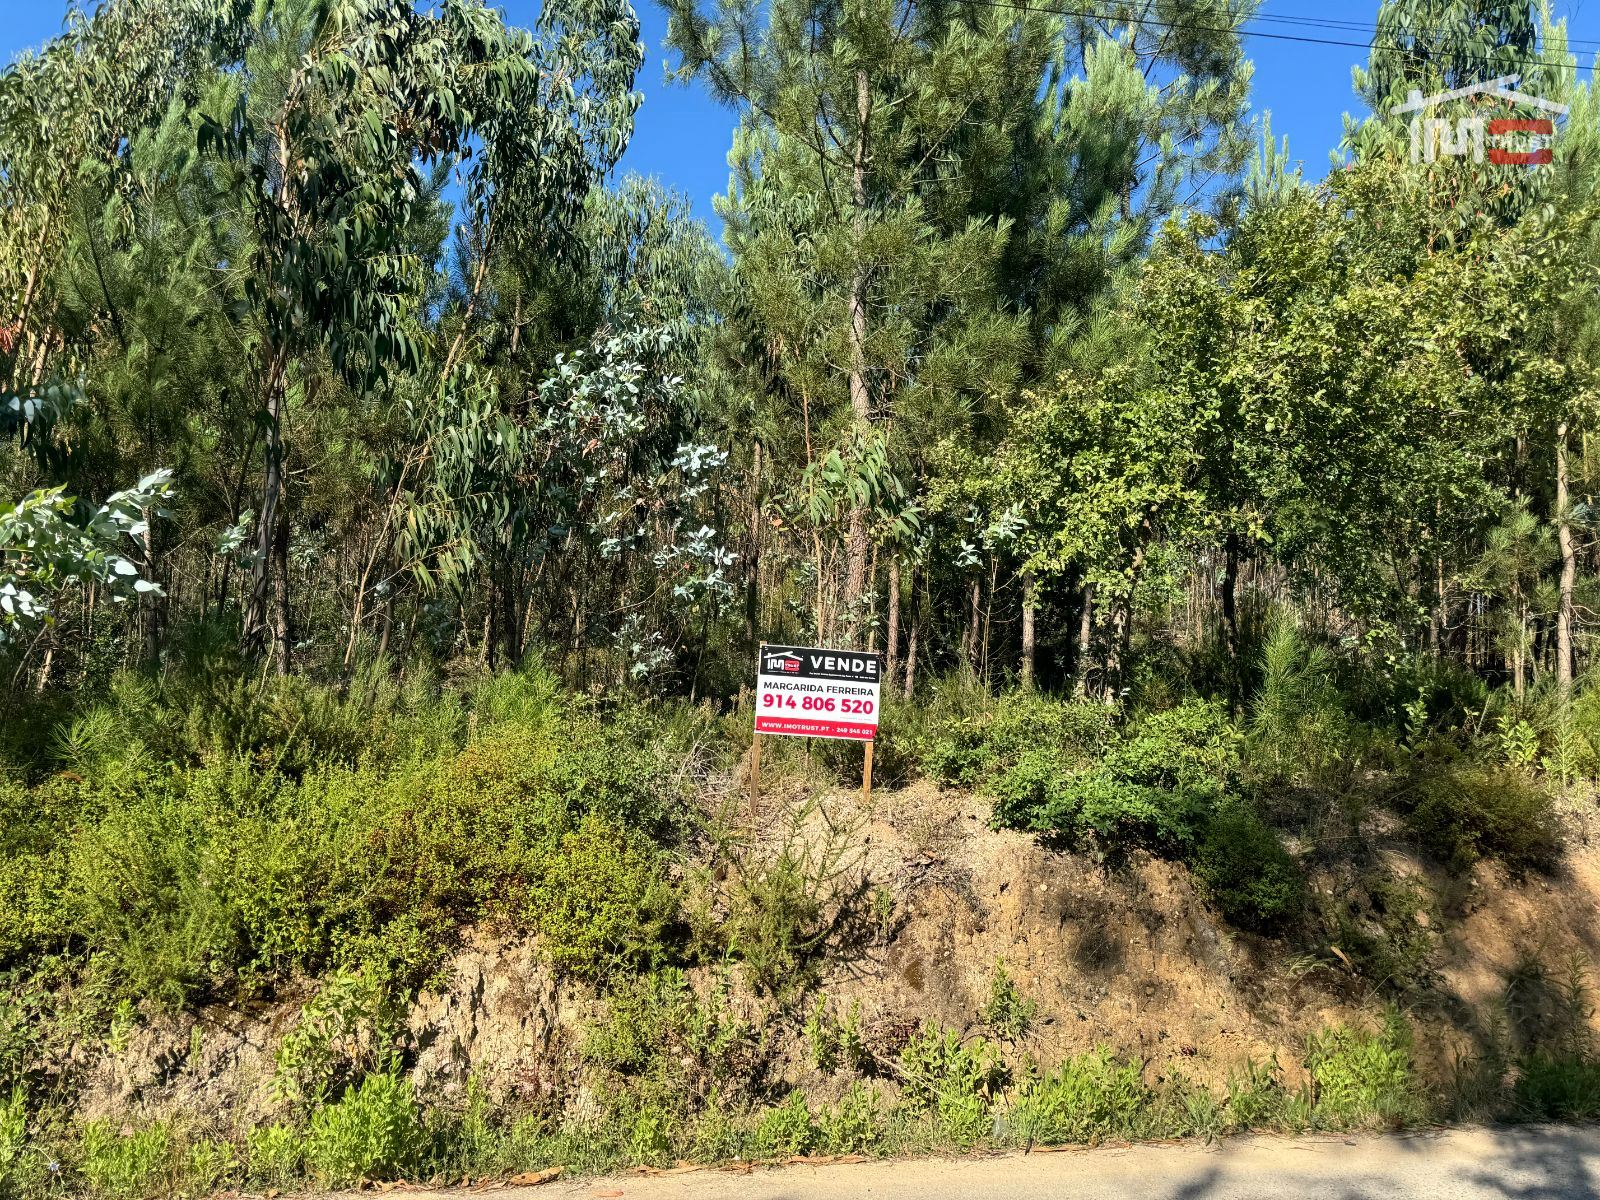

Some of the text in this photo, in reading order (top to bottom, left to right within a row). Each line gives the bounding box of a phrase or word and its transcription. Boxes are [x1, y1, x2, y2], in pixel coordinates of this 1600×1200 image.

[810, 655, 877, 674] VENDE
[763, 681, 874, 697] MARGARIDA FERREIRA
[763, 693, 874, 715] 914 806 520
[761, 721, 830, 732] WWW.IMOTRUST.PT
